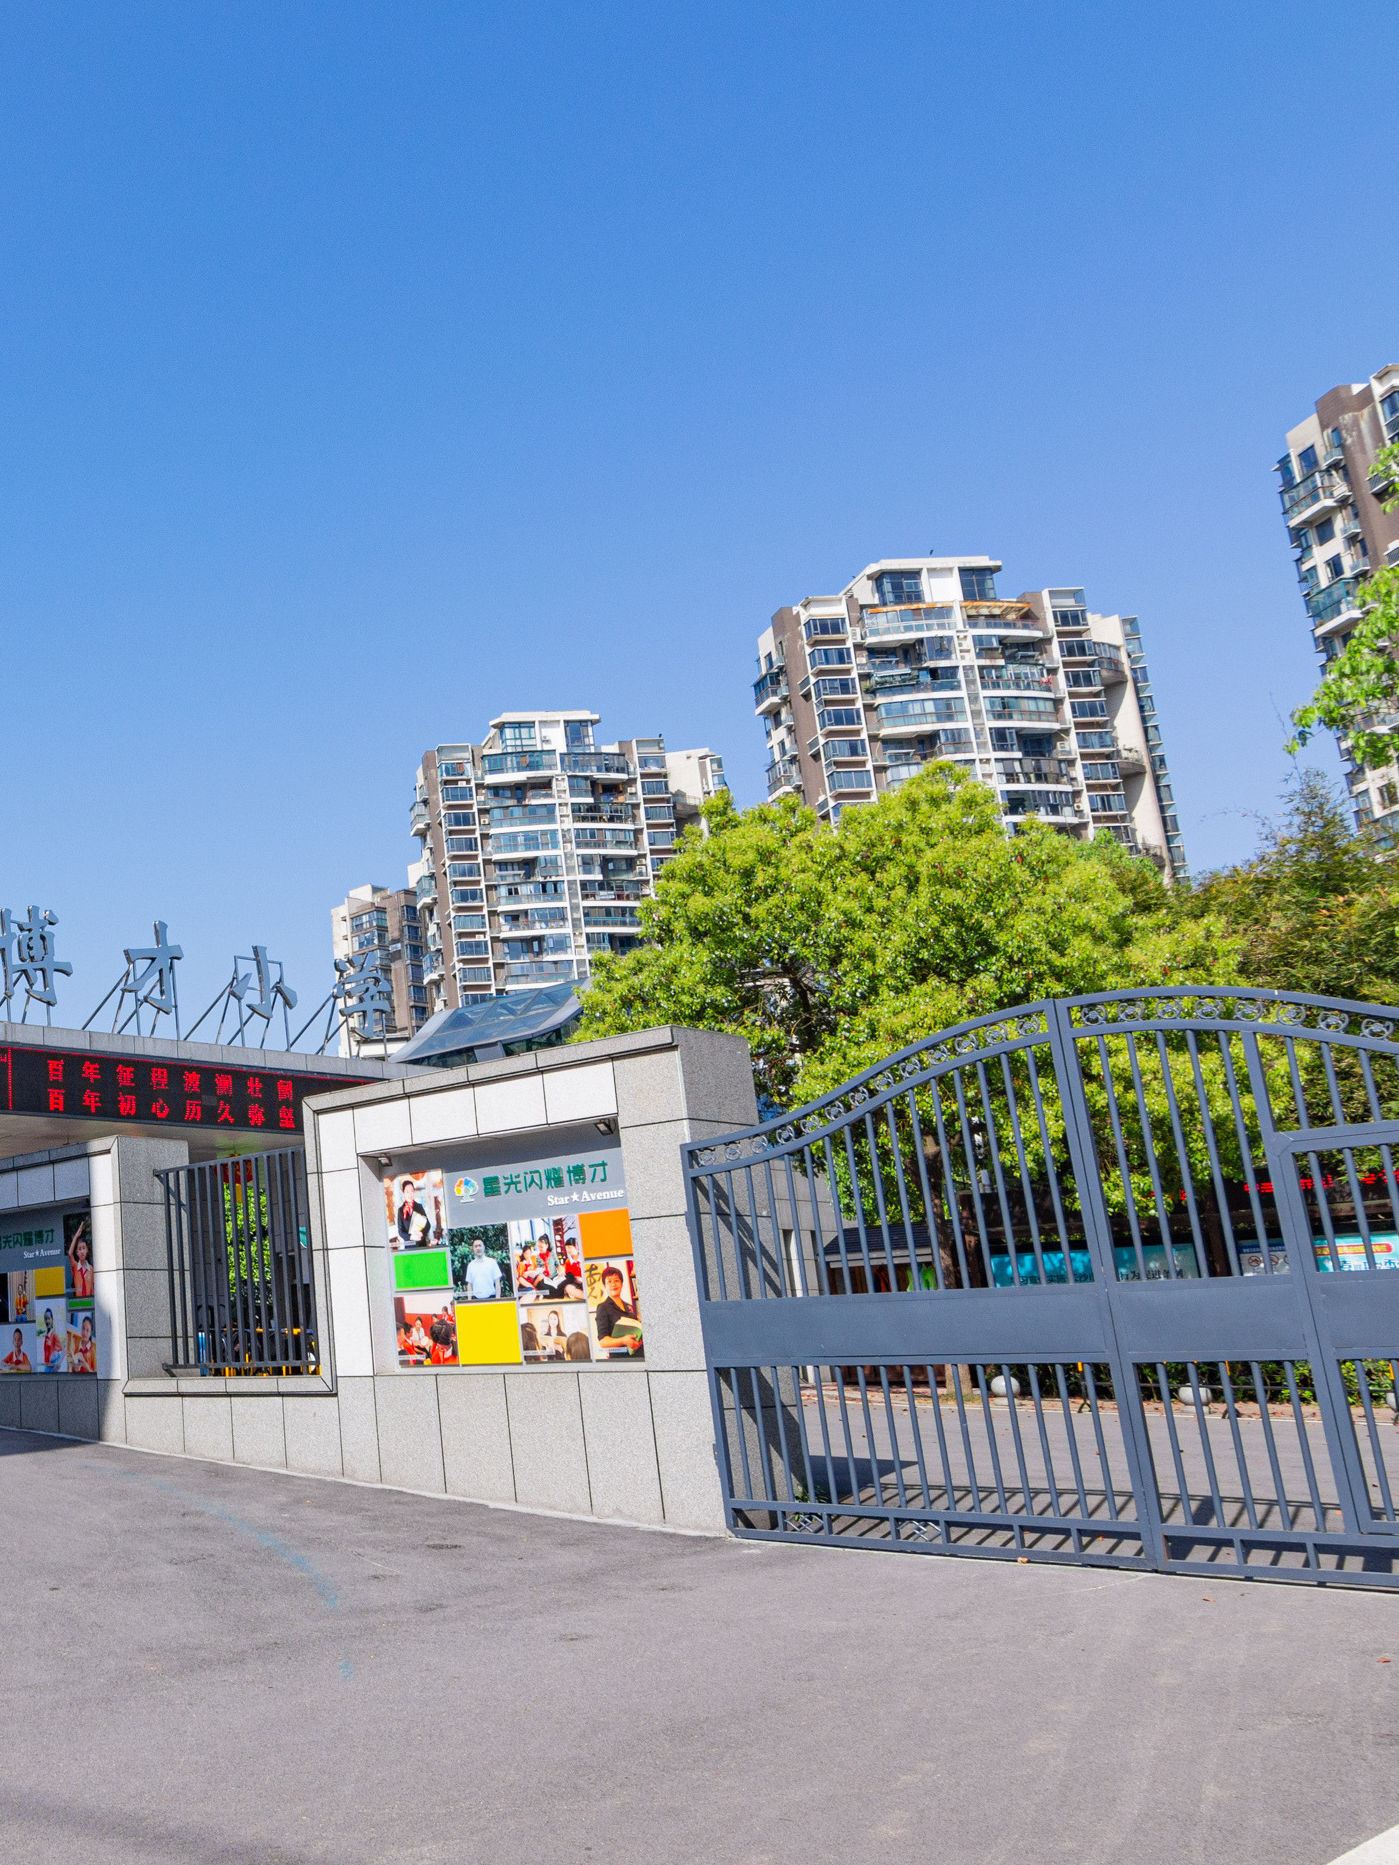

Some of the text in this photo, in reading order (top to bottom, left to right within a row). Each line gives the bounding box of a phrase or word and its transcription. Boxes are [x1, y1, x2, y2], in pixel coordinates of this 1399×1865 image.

[47, 1059, 294, 1101] 百年征程波澜壮阔
[47, 1088, 296, 1128] 百年初心历久弥坚
[482, 1160, 608, 1197] 星光闪耀博才
